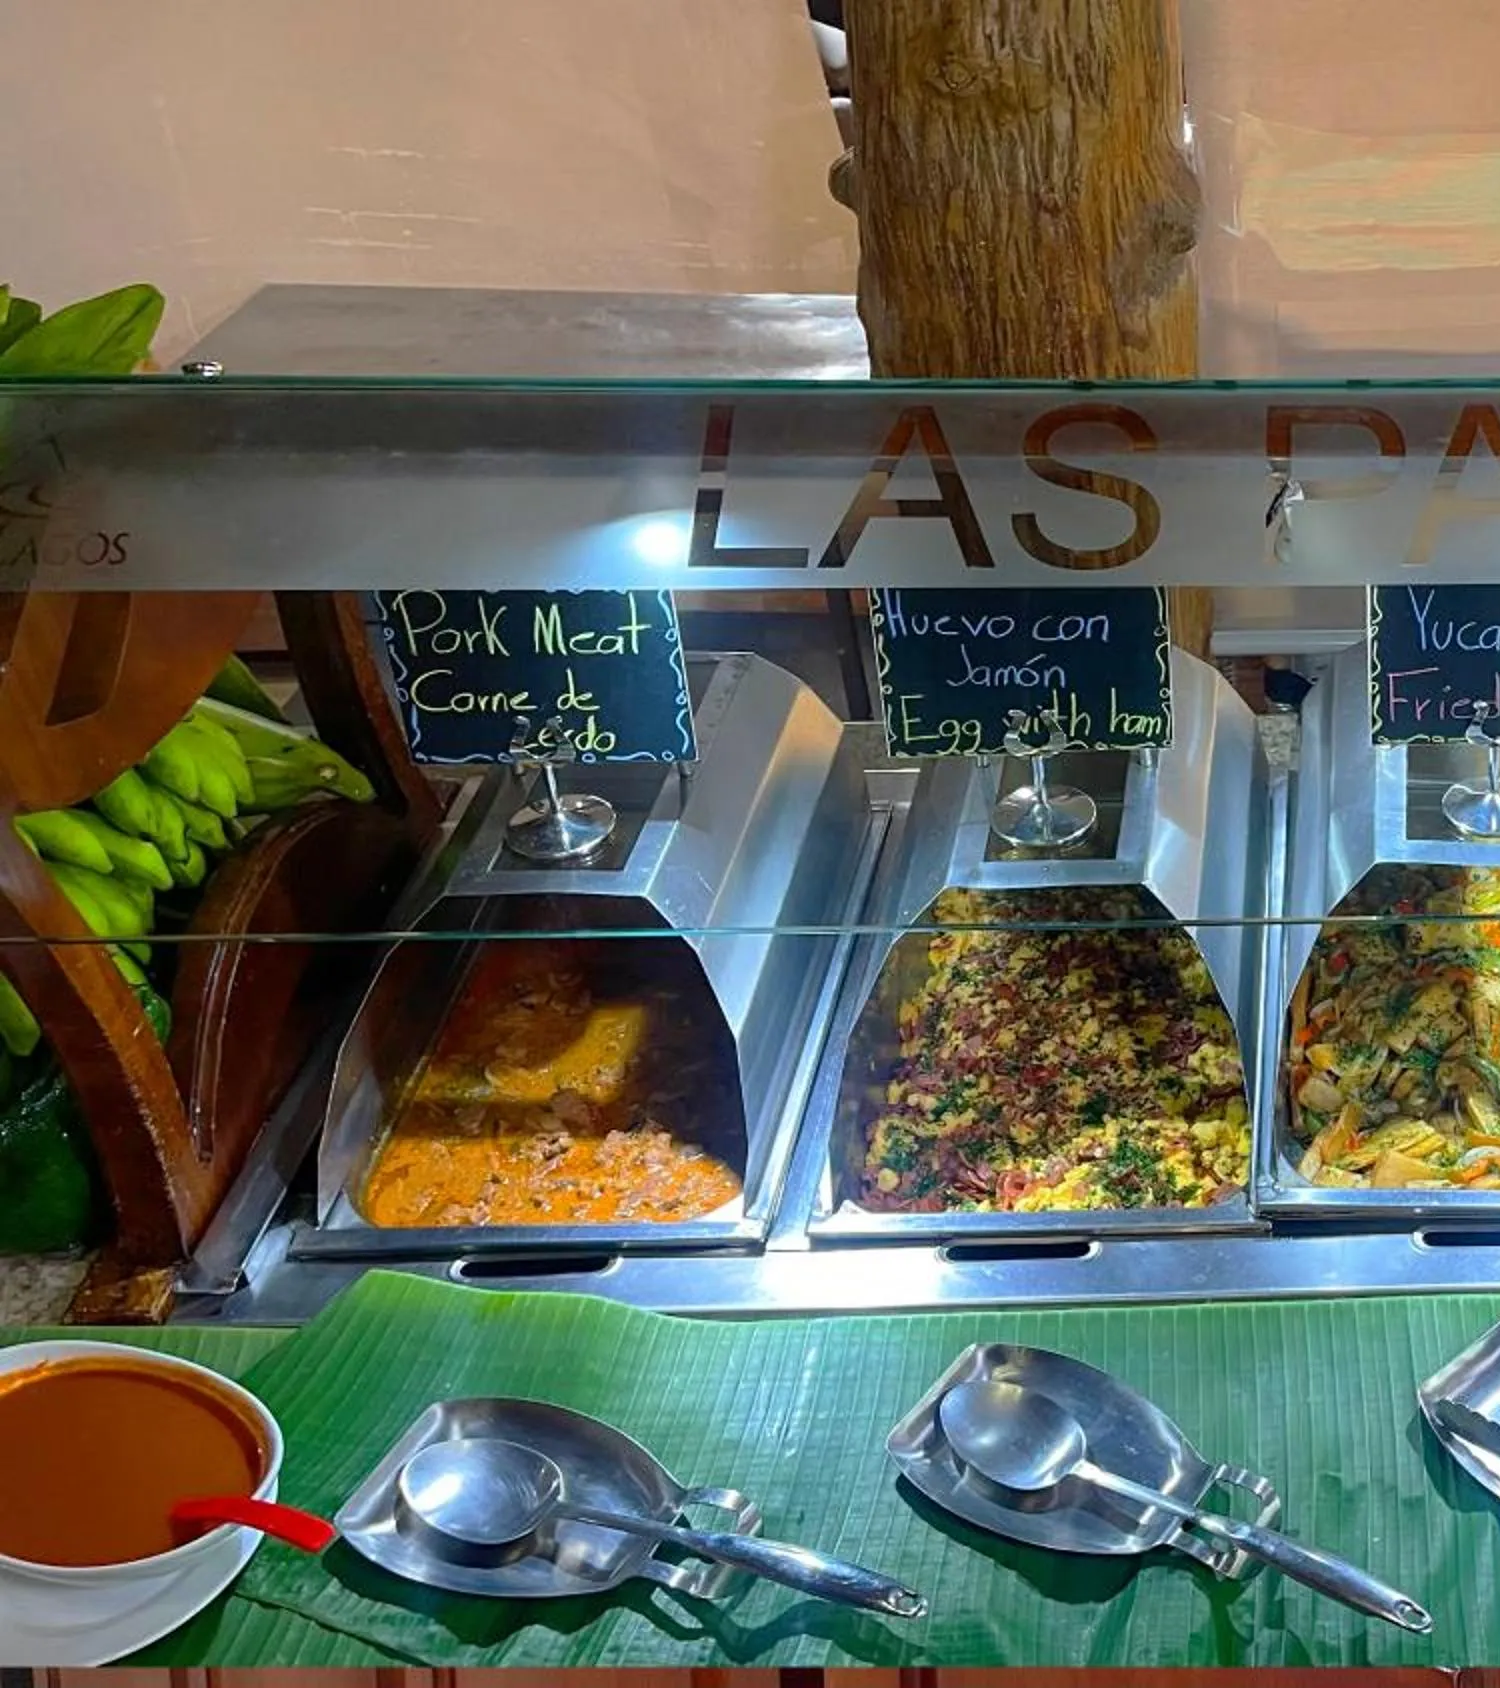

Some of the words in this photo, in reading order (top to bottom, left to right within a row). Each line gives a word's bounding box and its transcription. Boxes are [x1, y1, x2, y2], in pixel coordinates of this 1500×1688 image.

[688, 402, 1162, 571] LAS
[0, 520, 129, 567] AGOS
[393, 588, 511, 657] Pork
[533, 591, 652, 656] Meat
[883, 587, 1016, 641] Huevo
[1031, 614, 1111, 643] con
[411, 668, 540, 713] Carne
[556, 667, 600, 712] de
[946, 643, 1067, 689] Jamón
[520, 714, 617, 753] edo
[899, 694, 982, 755] Egg
[1109, 687, 1164, 738] ham
